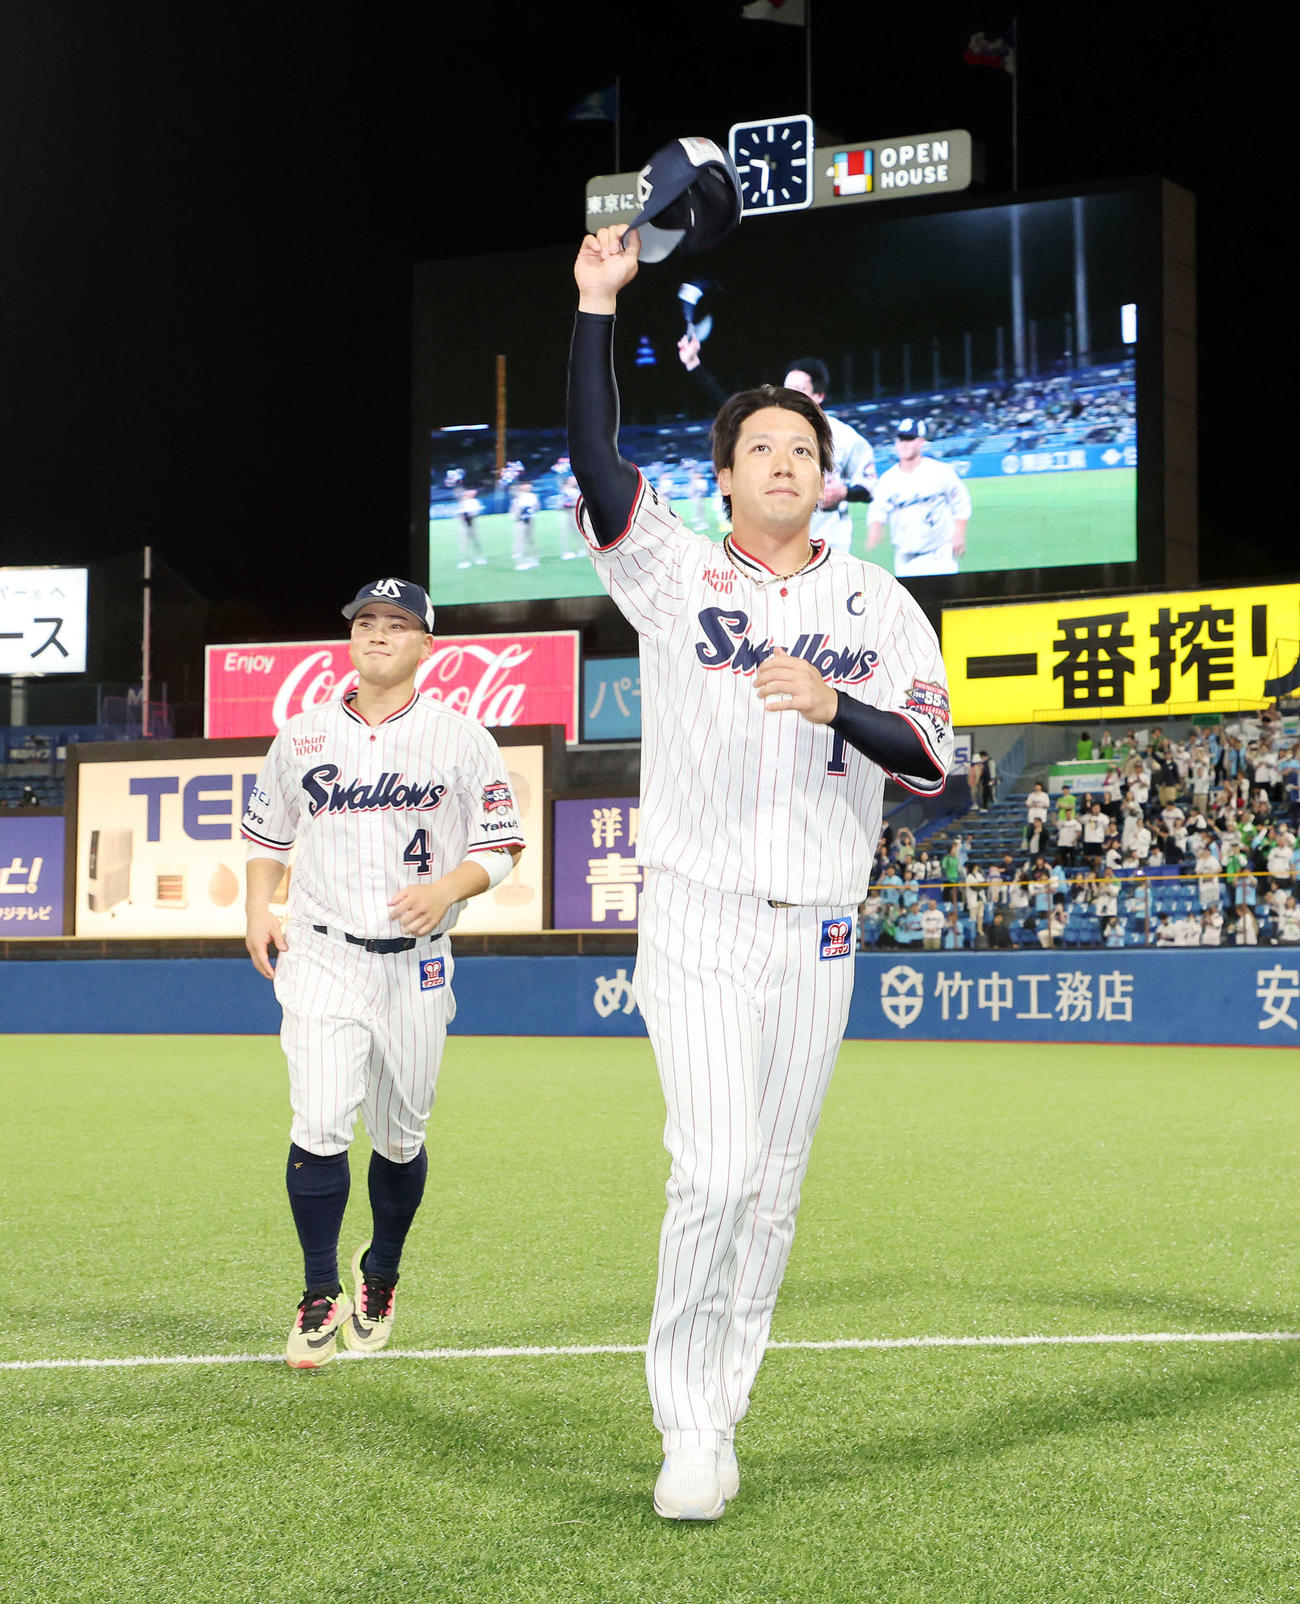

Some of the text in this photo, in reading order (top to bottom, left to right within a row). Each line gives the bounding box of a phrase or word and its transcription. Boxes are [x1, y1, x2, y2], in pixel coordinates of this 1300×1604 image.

[880, 140, 949, 168] OPEN
[881, 164, 949, 189] HOUSE
[847, 591, 865, 616] C
[695, 607, 879, 684] Swllows
[224, 652, 275, 674] Enjoy
[589, 677, 641, 718] パ
[292, 735, 327, 746] Yakult
[295, 744, 323, 756] 1000
[302, 763, 448, 819] Swallows
[403, 828, 433, 875] 4
[934, 971, 1134, 1022] 竹中工務店
[1256, 964, 1300, 1031] 安
